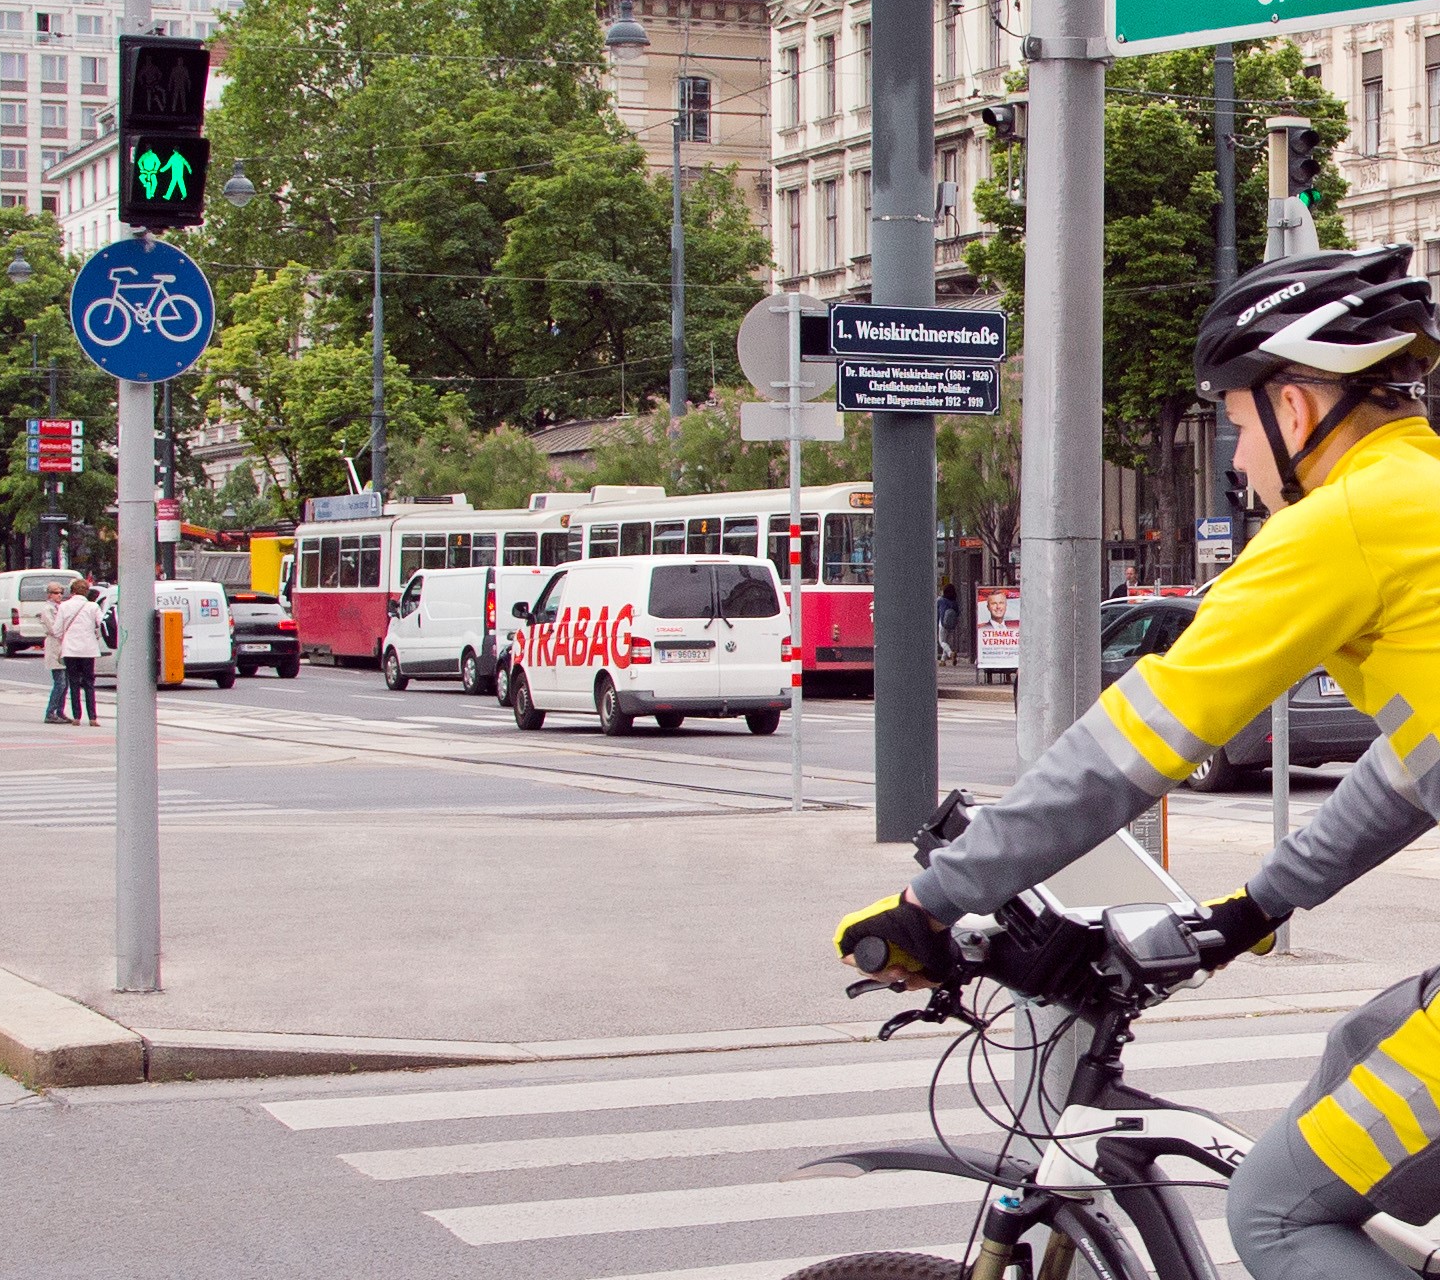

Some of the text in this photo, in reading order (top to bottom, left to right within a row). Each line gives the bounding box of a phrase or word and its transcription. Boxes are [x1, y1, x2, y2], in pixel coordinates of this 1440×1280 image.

[855, 320, 1000, 346] Weiskirchnerstraße
[845, 366, 858, 377] Dr.
[858, 367, 891, 379] Richard
[891, 367, 944, 381] Weiskirchner
[855, 392, 885, 405] Wiener
[886, 394, 944, 408] Bürgermeister
[944, 395, 961, 407] 1912
[967, 396, 984, 408] 1919
[700, 520, 707, 533] 2
[513, 603, 633, 670] STRABAG
[982, 630, 1013, 638] STIMME
[982, 638, 1020, 646] VERNUN
